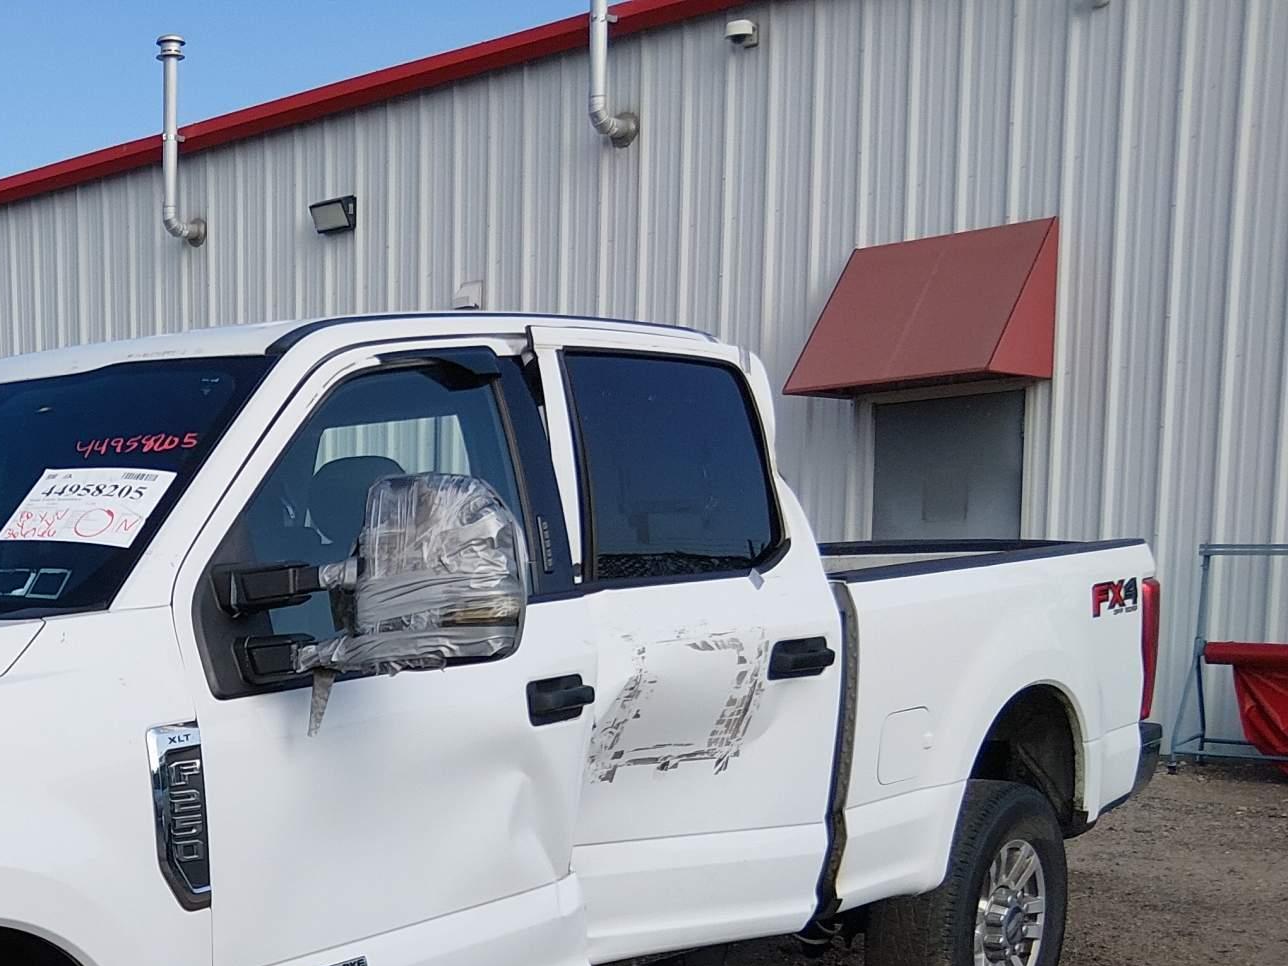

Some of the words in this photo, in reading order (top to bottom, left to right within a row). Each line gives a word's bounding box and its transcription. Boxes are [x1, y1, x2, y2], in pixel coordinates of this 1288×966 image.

[76, 433, 198, 459] 44958205
[41, 483, 147, 500] 44958205
[1092, 577, 1138, 618] FX4
[168, 733, 191, 745] XLT
